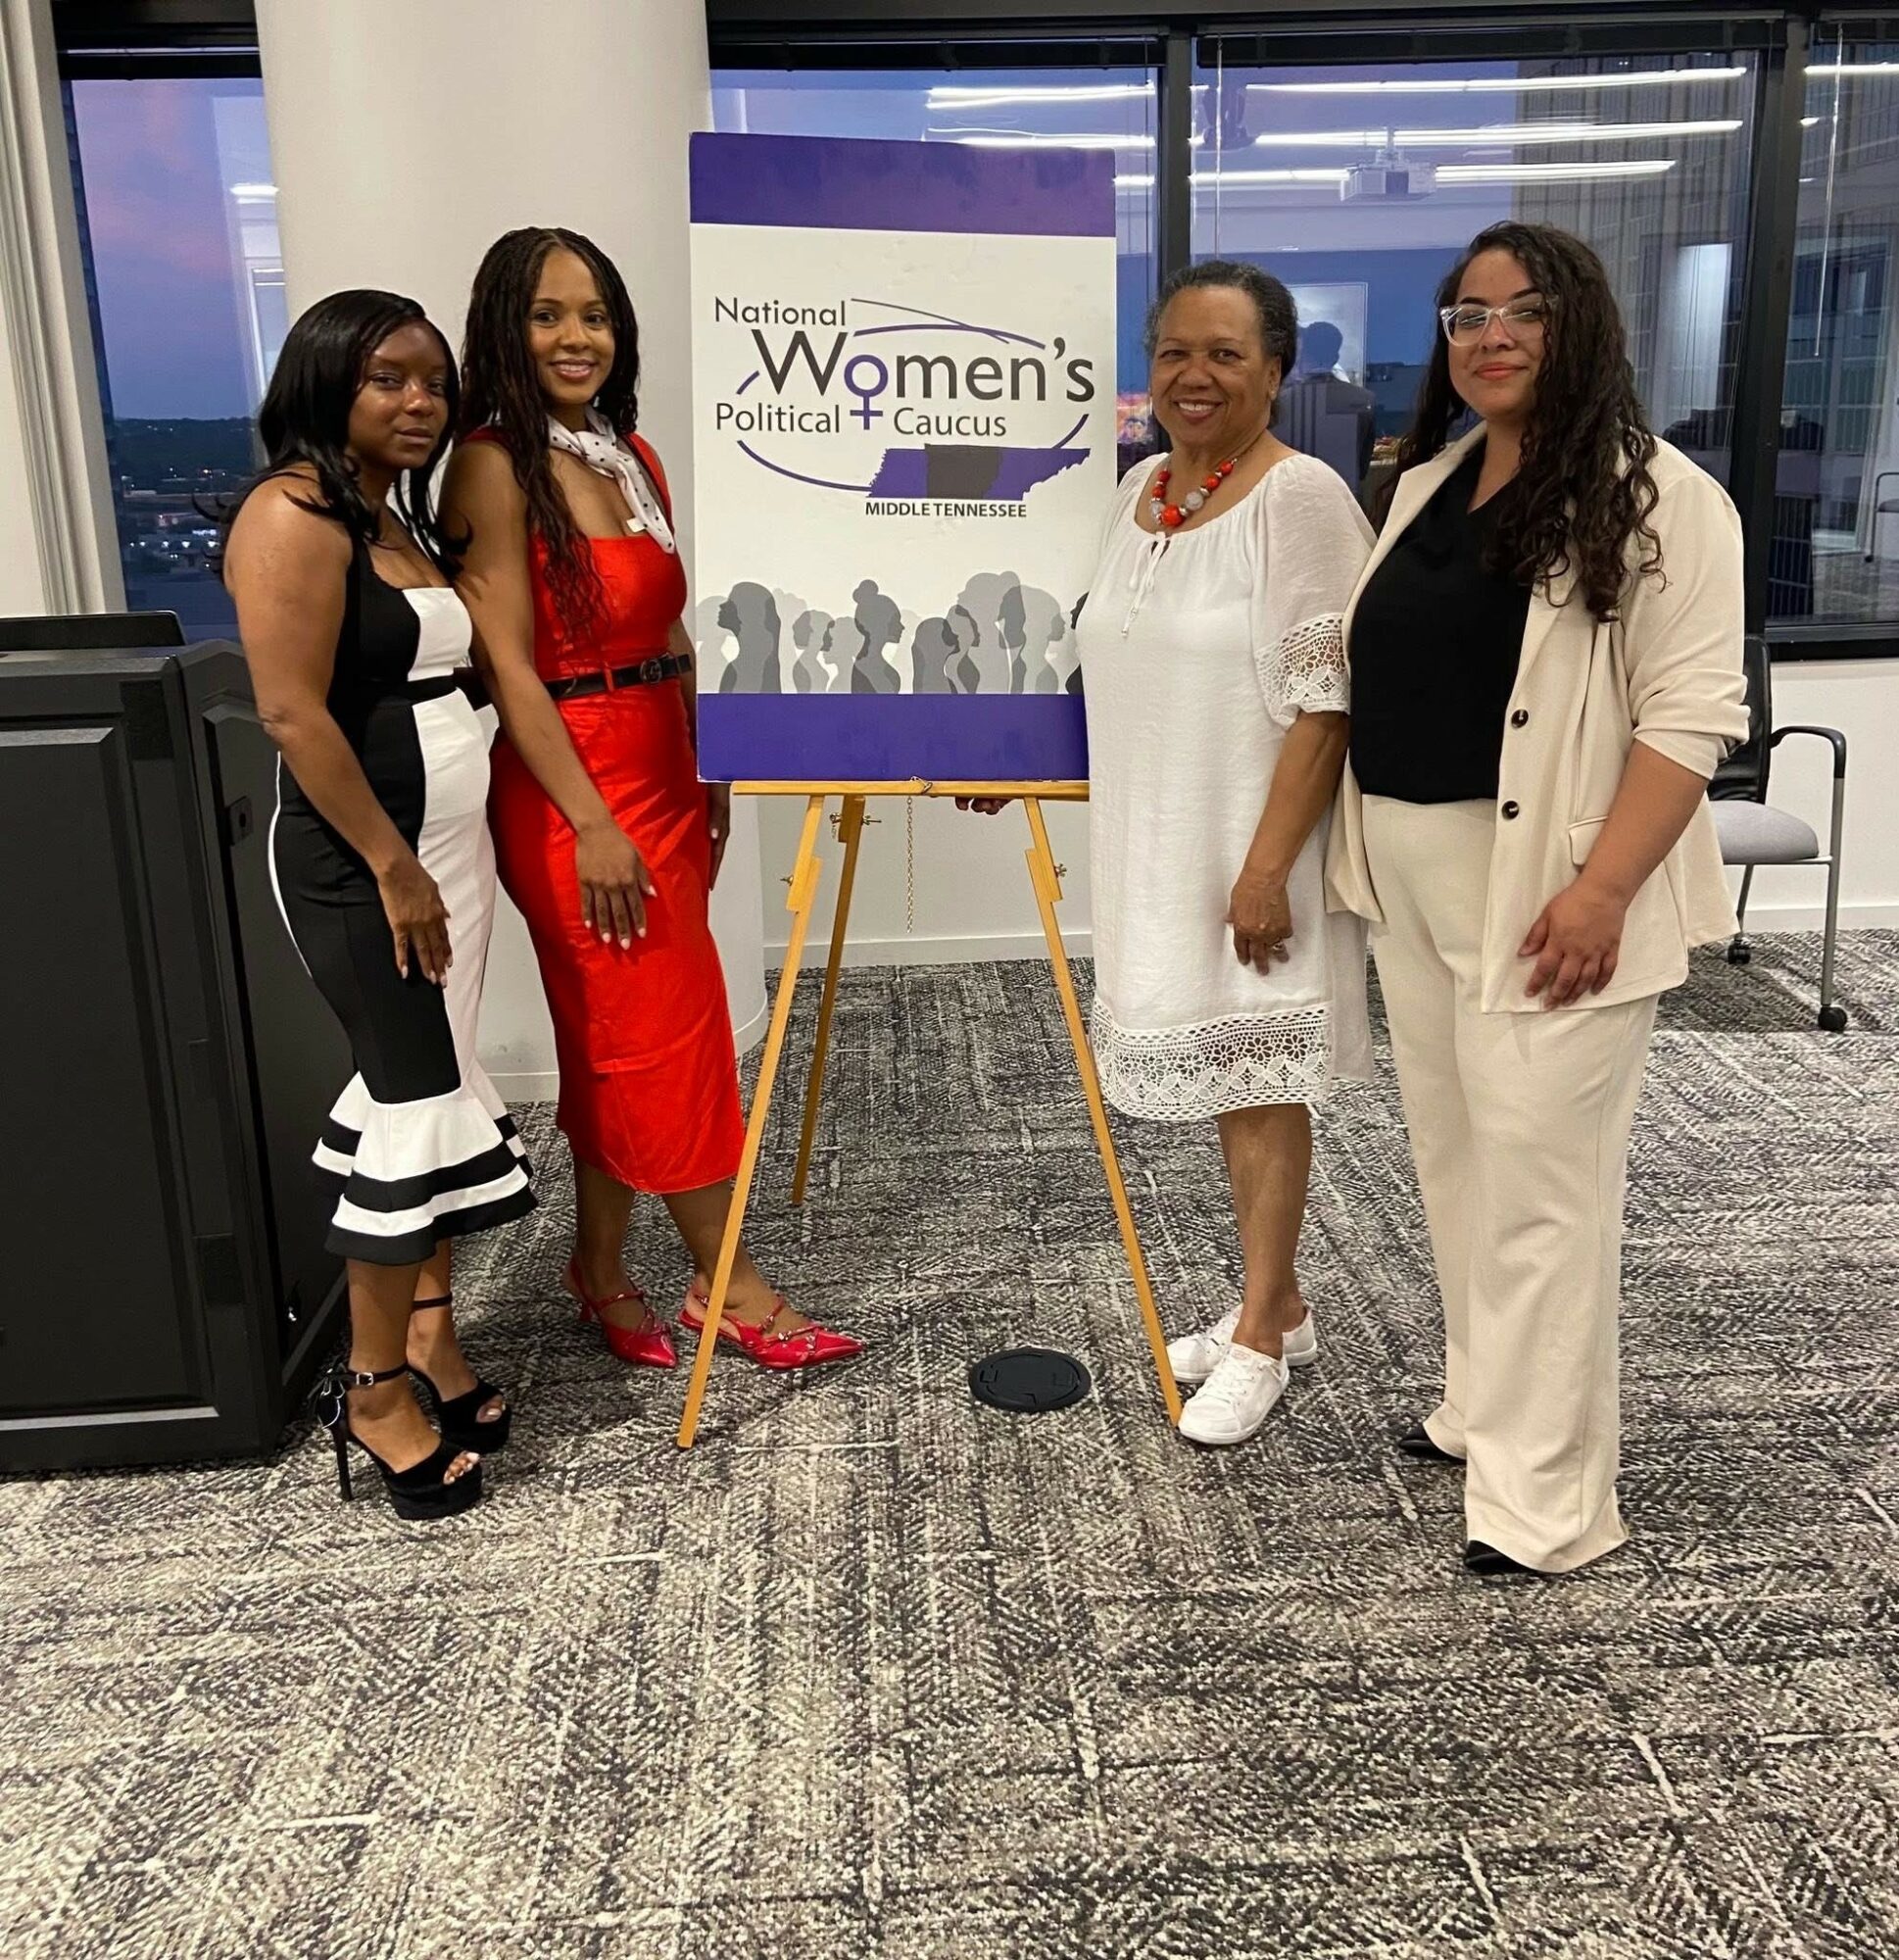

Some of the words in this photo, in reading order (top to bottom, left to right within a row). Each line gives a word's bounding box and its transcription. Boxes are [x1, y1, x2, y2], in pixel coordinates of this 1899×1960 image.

[714, 296, 846, 326] National
[751, 328, 1096, 430] Women's
[716, 403, 841, 433] Political
[893, 407, 1007, 437] Caucus
[865, 502, 930, 516] MIDDLE
[933, 502, 1028, 517] TENNESSEE
